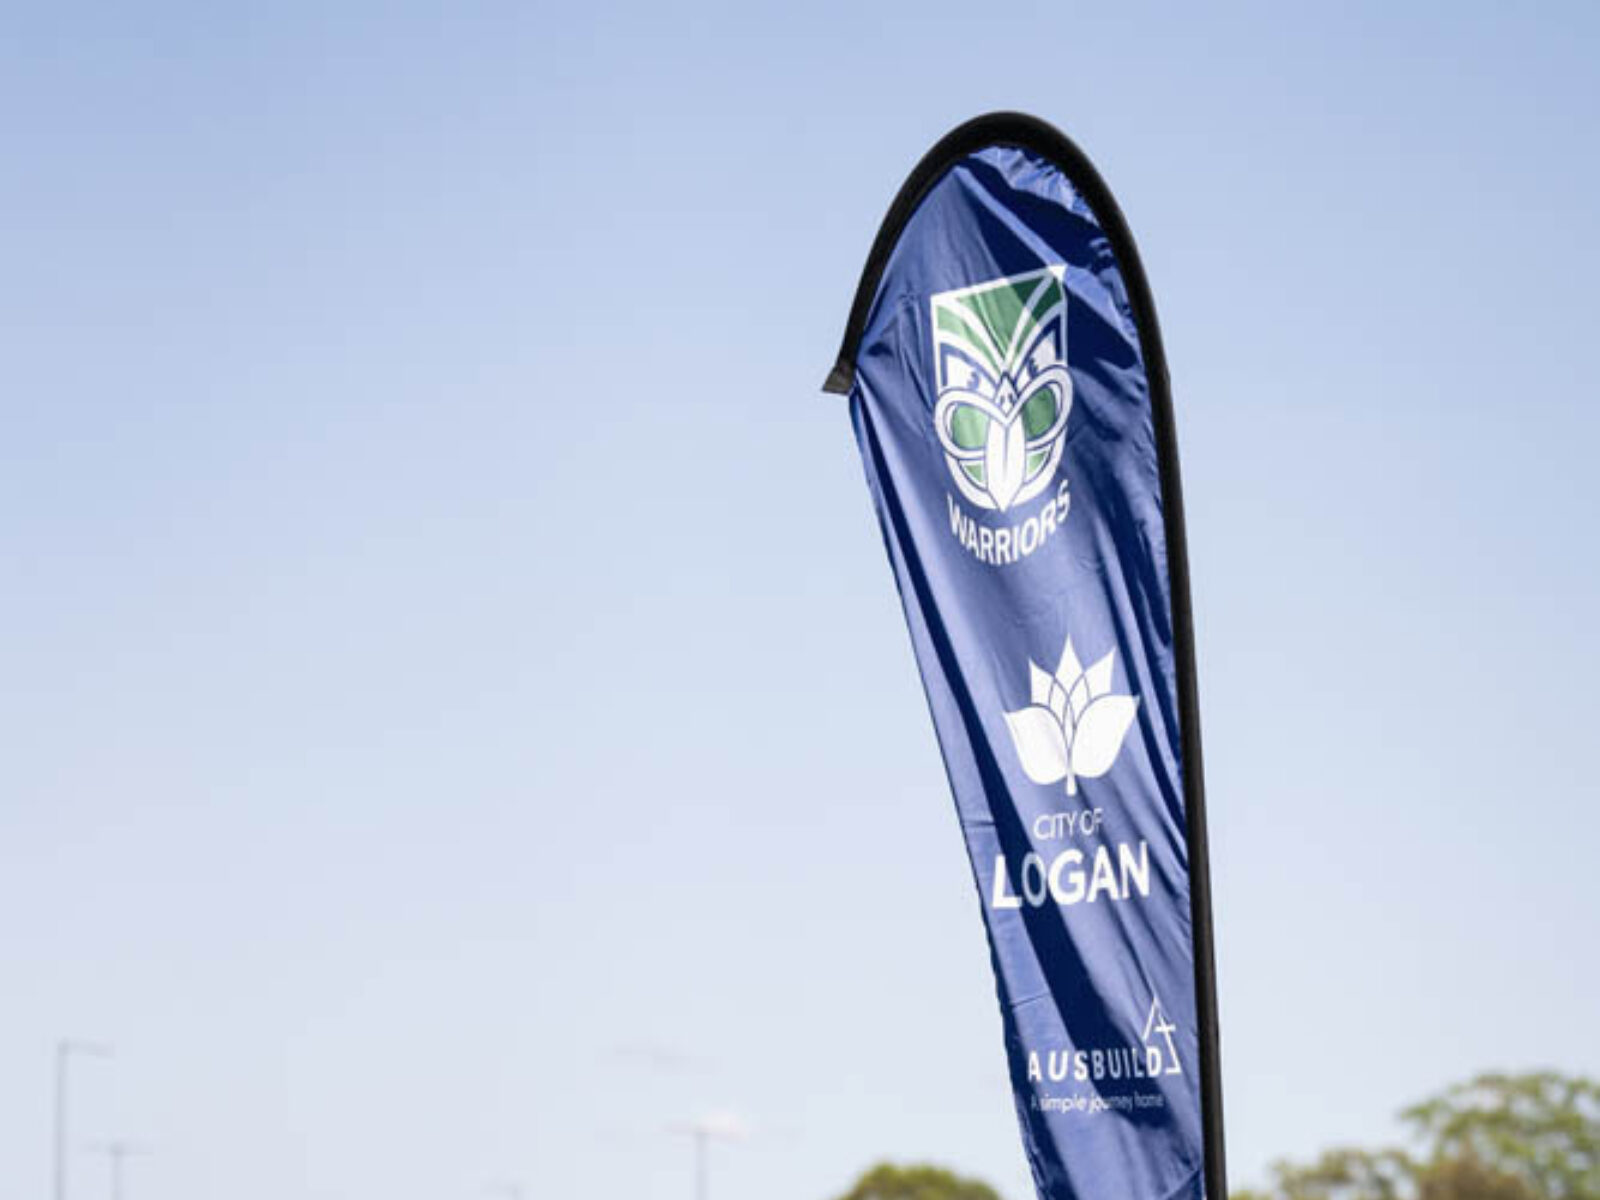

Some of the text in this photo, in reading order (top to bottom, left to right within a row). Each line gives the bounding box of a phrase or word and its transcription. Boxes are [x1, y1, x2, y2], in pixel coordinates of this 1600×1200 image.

[946, 478, 1071, 566] WARRIORS
[1033, 807, 1103, 840] CITY OF
[991, 839, 1150, 908] LOGAN
[1027, 1045, 1163, 1083] AUSBUILD
[1040, 1092, 1087, 1115] simple
[1088, 1092, 1134, 1115] journey
[1134, 1090, 1164, 1108] home
